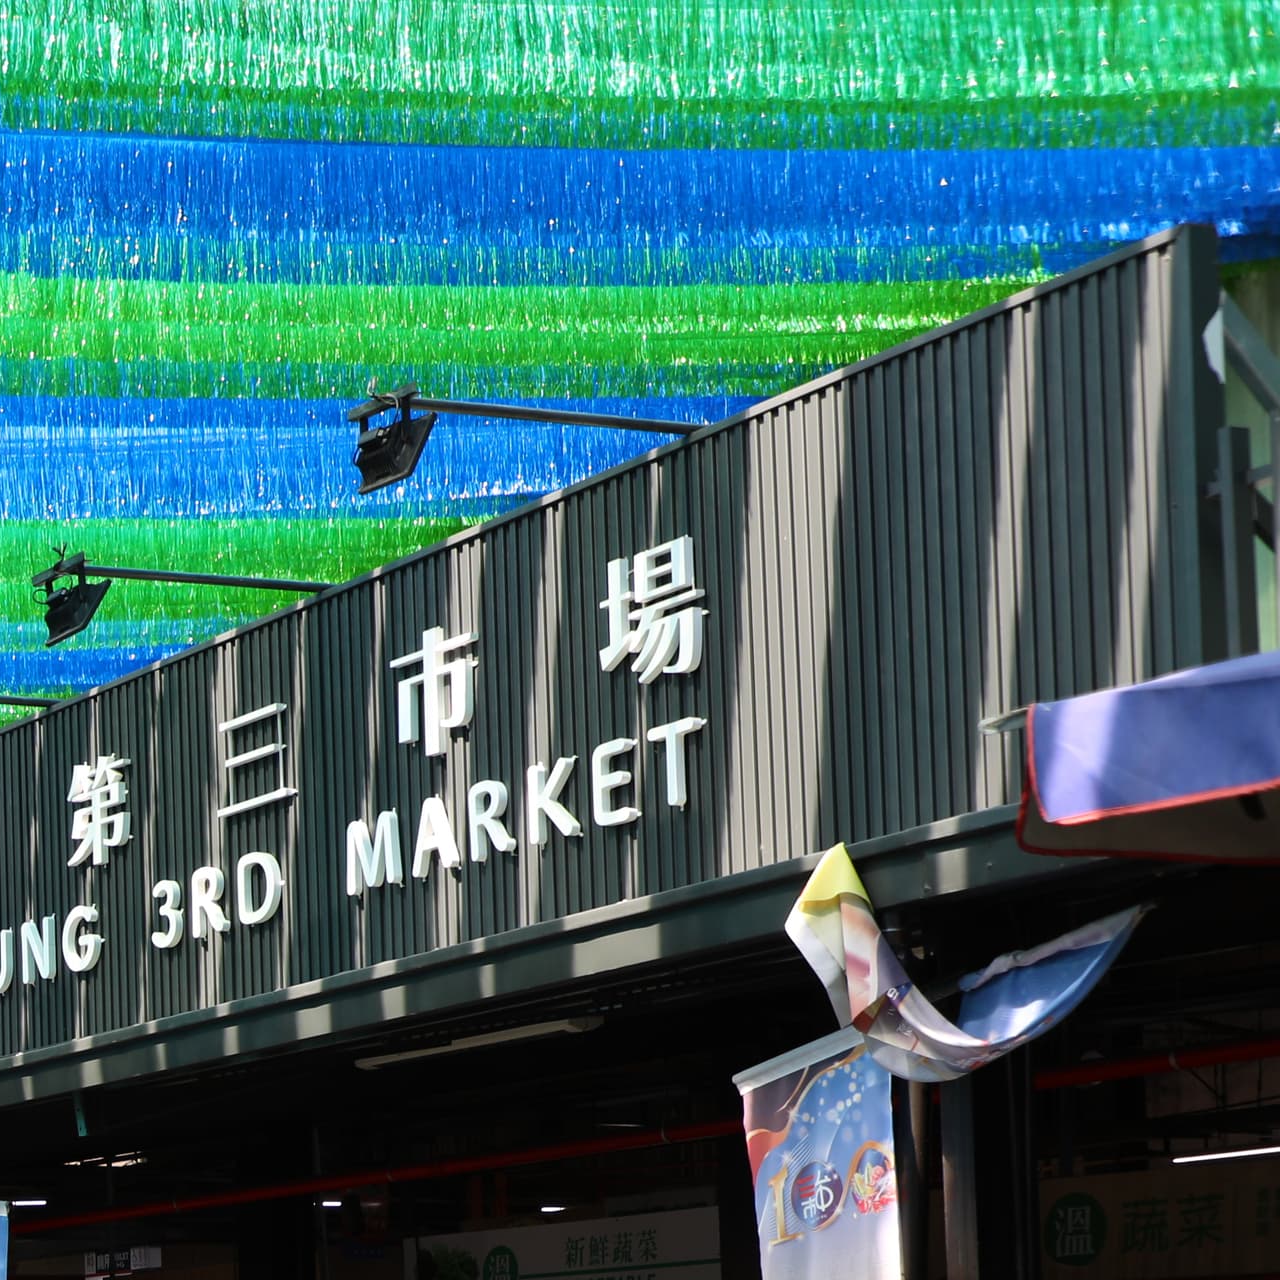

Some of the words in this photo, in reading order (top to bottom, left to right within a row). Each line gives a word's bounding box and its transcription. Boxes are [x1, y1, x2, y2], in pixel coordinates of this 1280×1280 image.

[151, 850, 286, 950] 3RD
[346, 716, 708, 897] MARKET
[565, 1229, 658, 1268] 新鮮蔬菜
